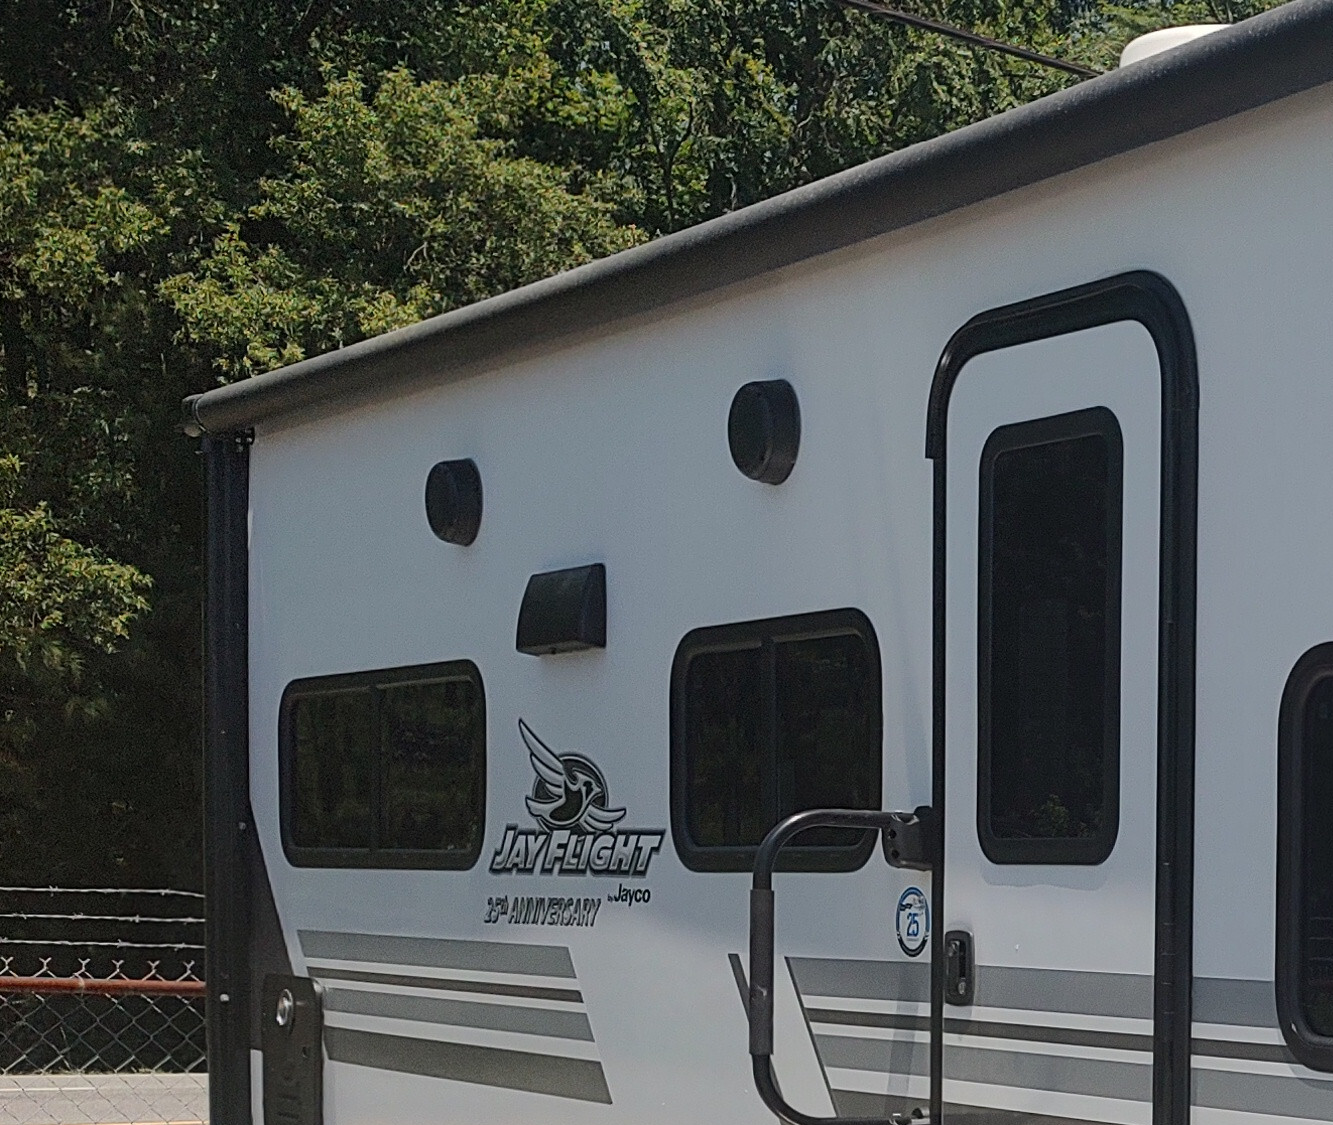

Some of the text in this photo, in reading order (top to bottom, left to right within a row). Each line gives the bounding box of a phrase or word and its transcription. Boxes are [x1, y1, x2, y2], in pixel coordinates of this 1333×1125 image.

[490, 823, 666, 878] JAY FLIGHT
[613, 883, 651, 906] Jayco
[484, 895, 601, 927] 25th ANNIVERSARY
